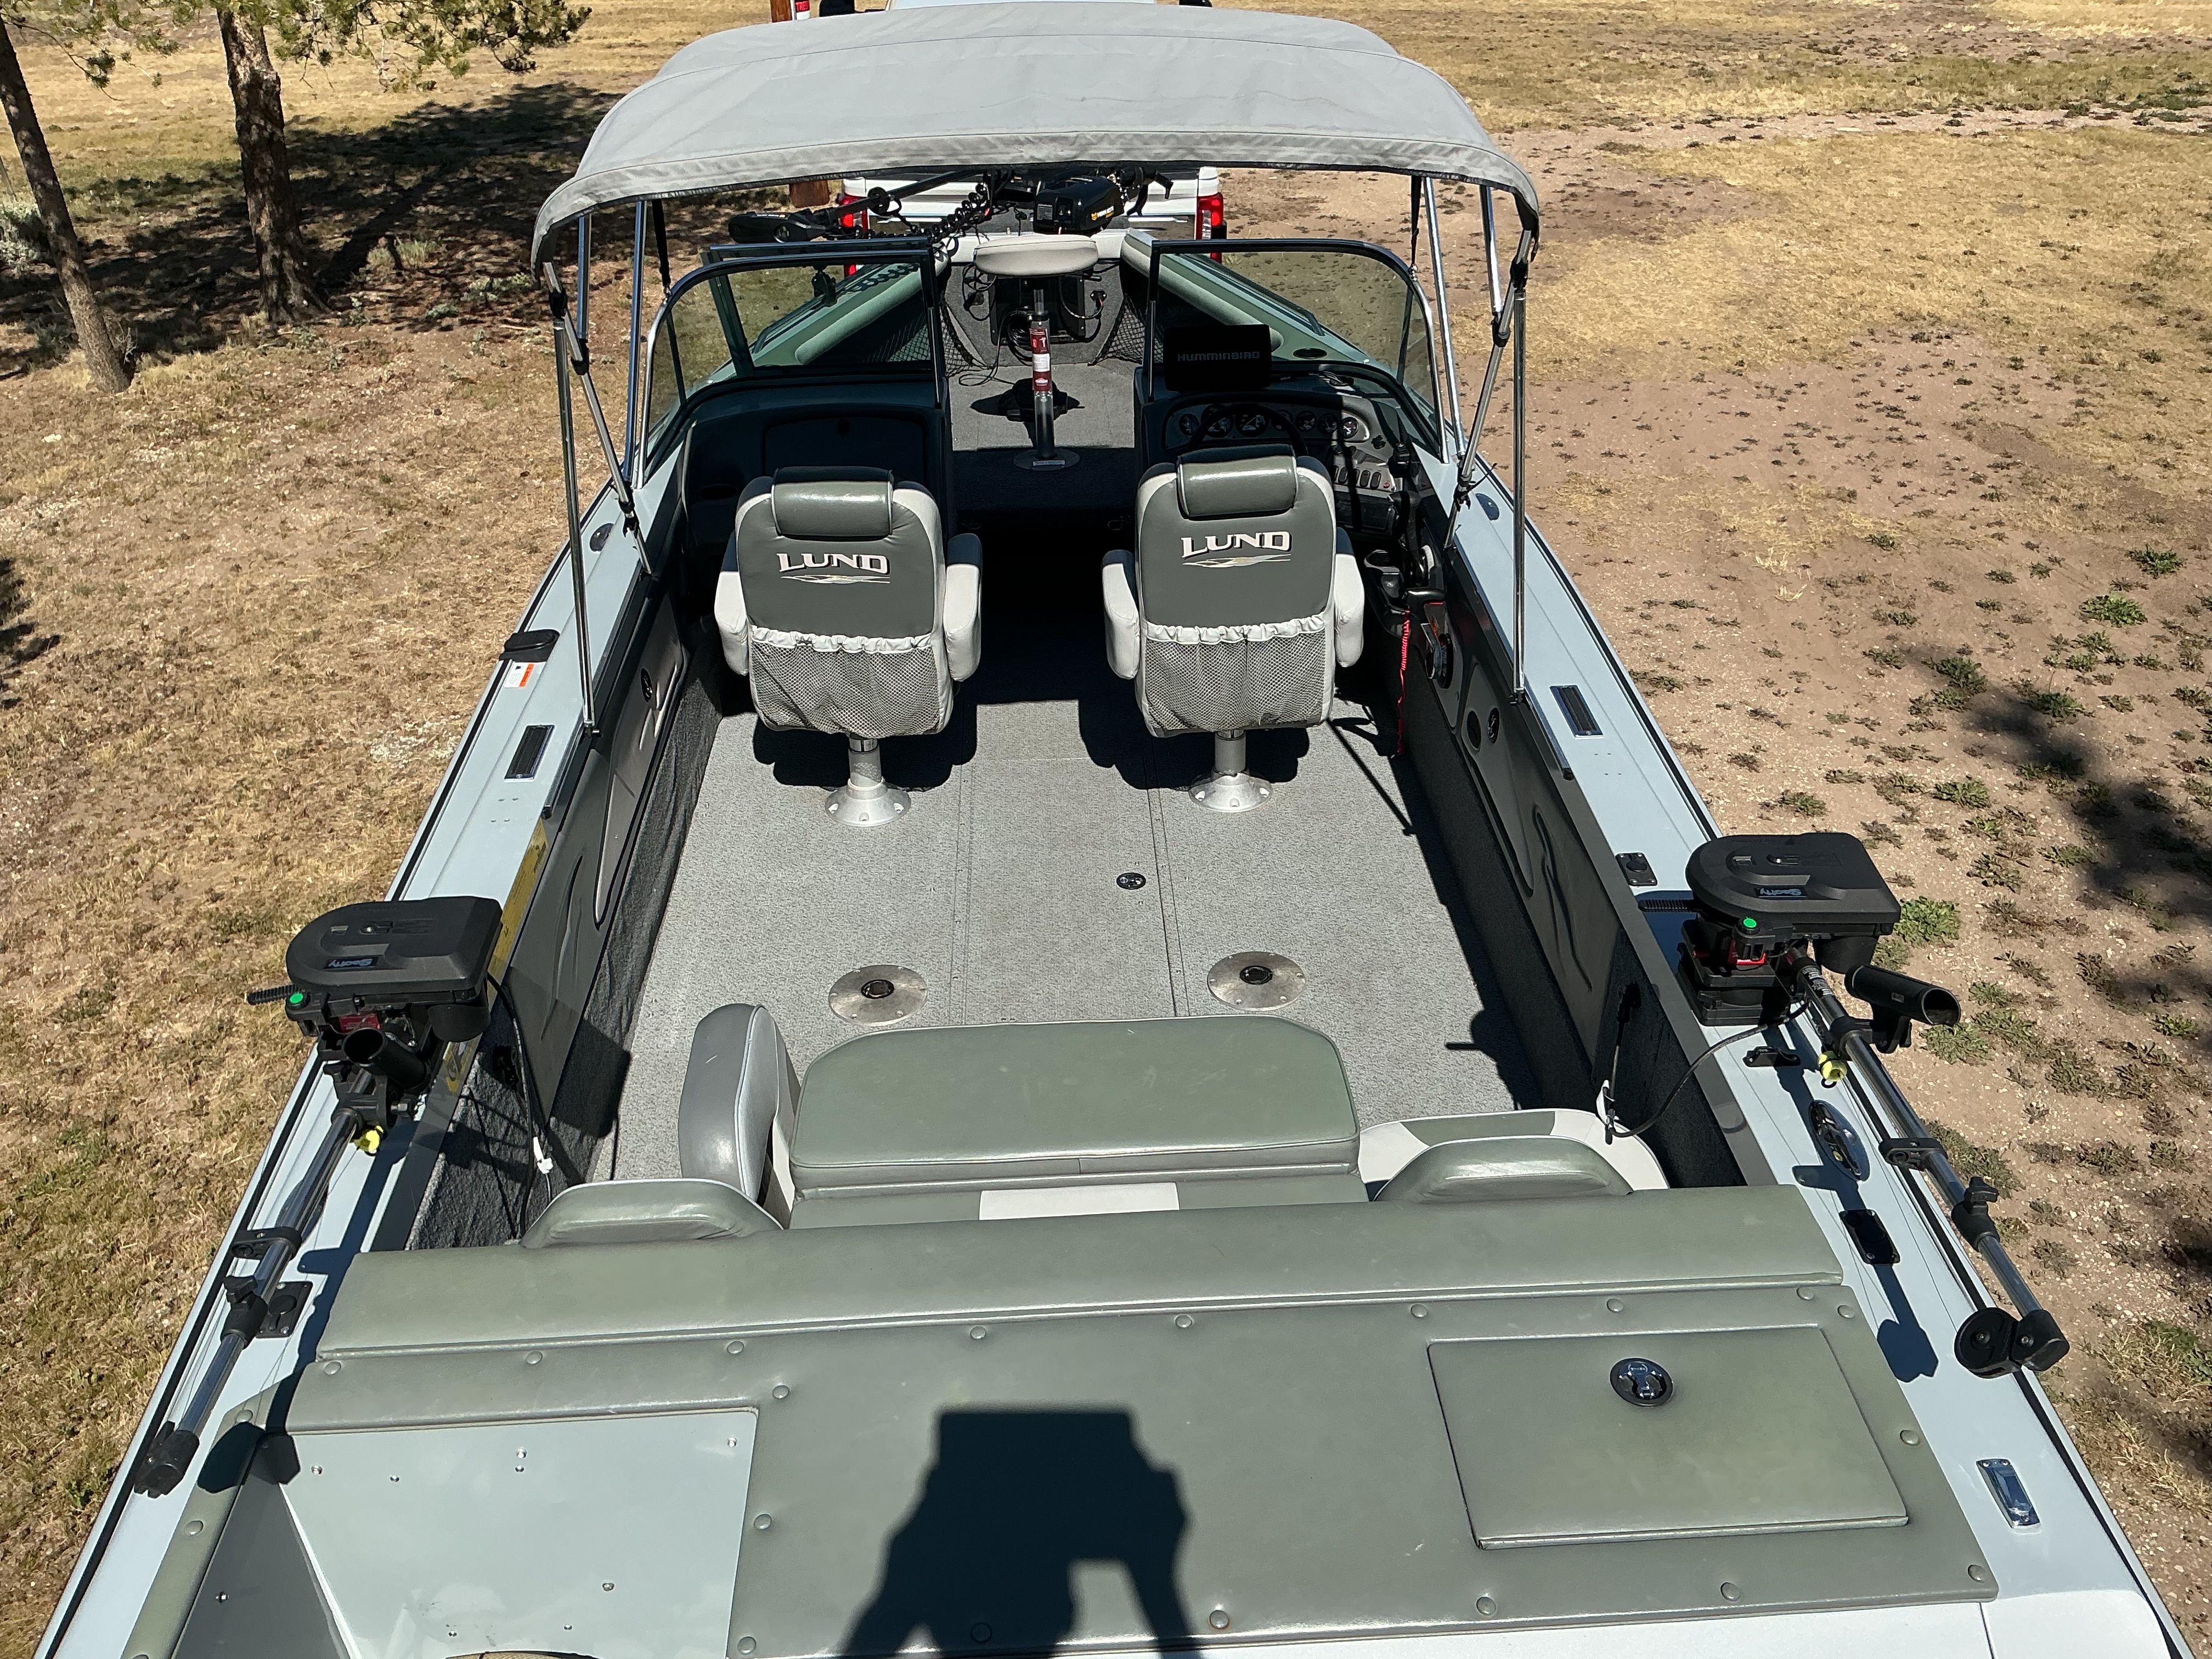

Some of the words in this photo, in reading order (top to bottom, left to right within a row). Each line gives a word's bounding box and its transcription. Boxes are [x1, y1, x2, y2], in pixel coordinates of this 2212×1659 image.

[1177, 352, 1260, 361] HUMMINBIRD
[1181, 531, 1291, 560] LUND
[776, 553, 890, 574] LUND
